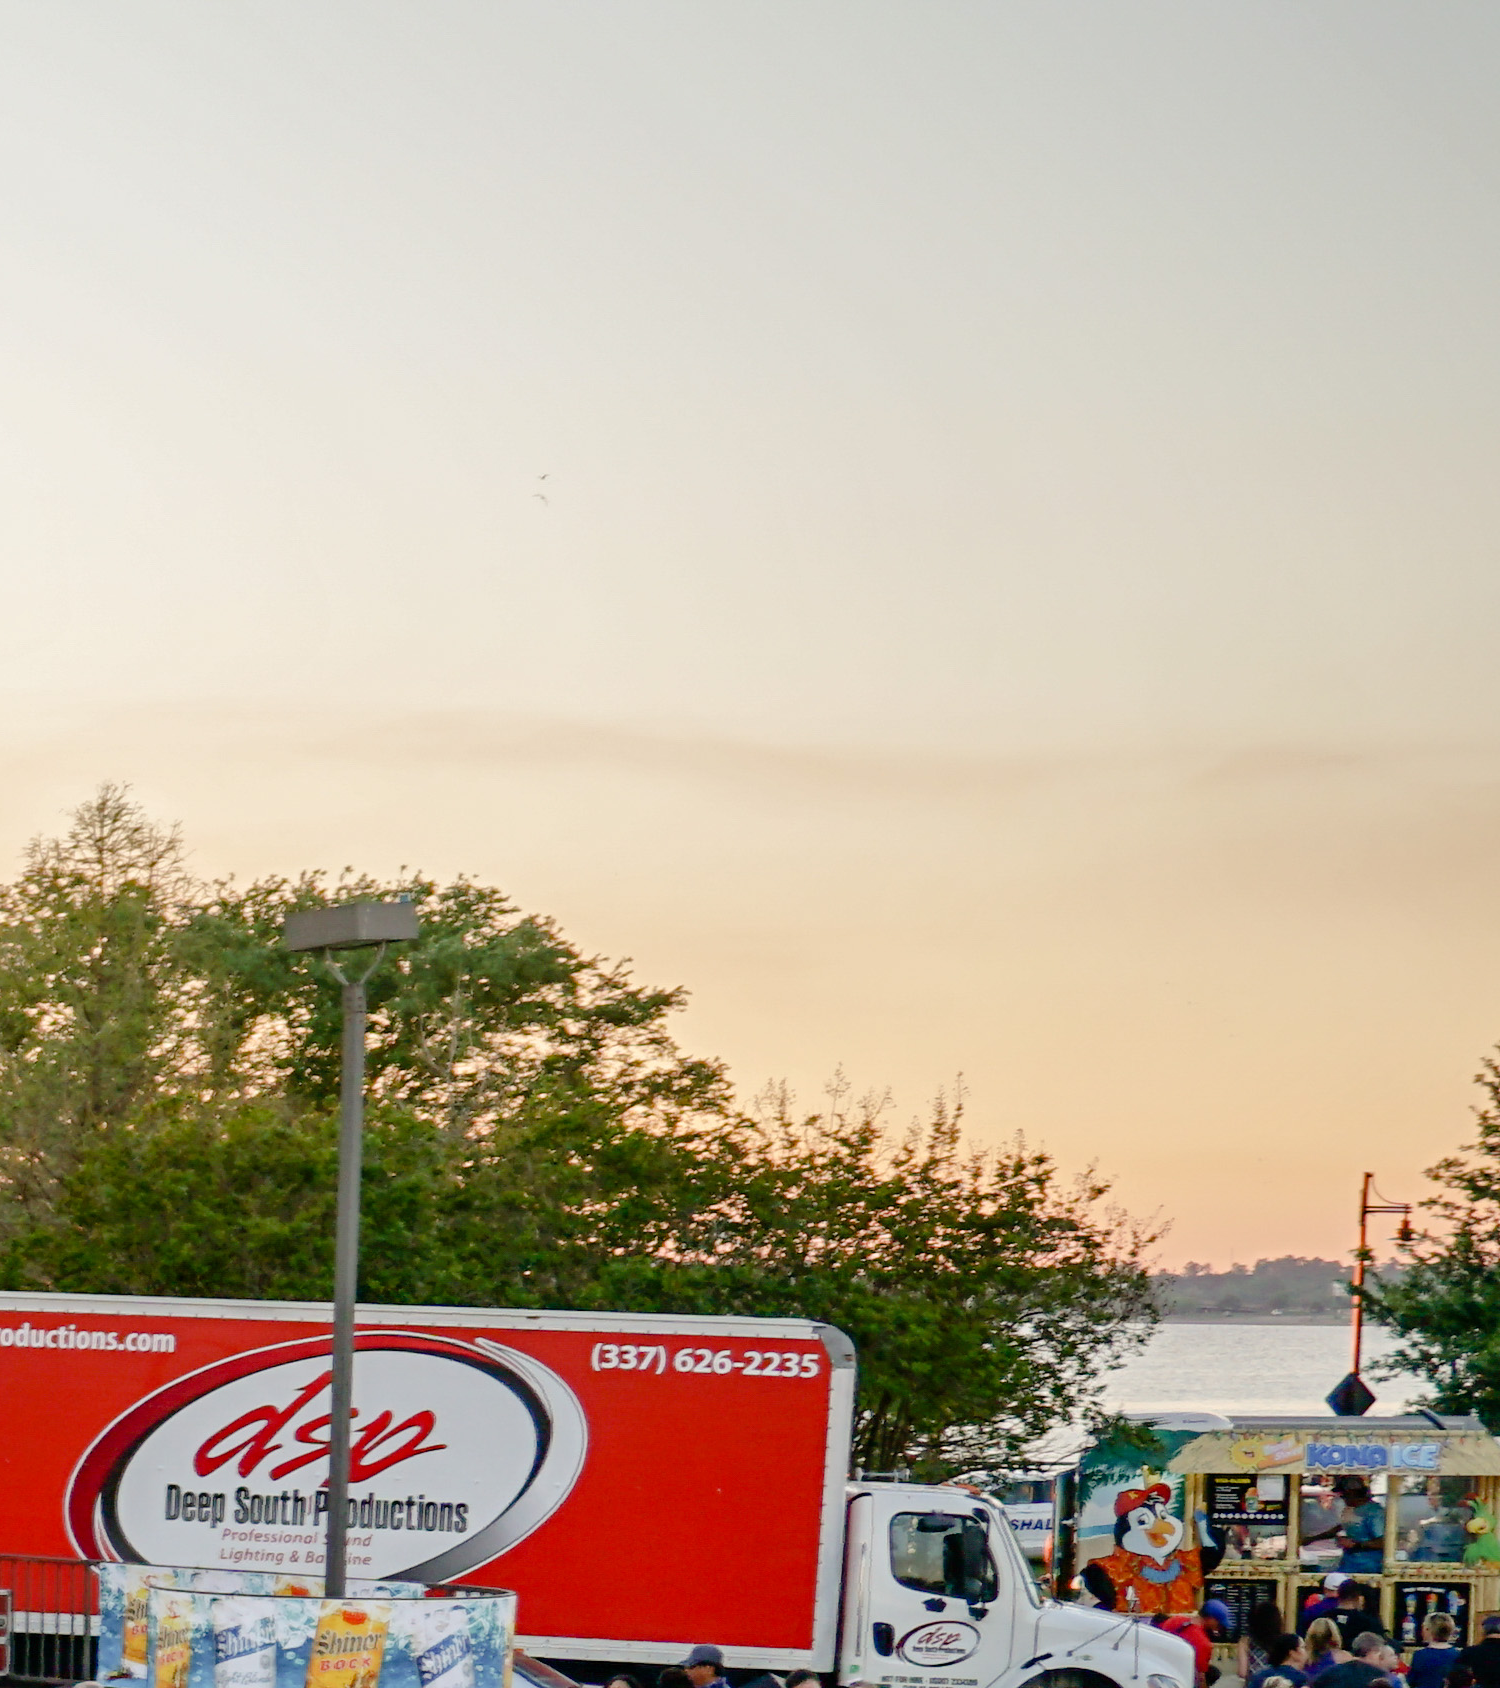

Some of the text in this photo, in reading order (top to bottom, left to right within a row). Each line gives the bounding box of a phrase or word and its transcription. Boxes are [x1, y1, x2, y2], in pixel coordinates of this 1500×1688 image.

[591, 1342, 821, 1378] (337) 626-2235
[1306, 1443, 1388, 1469] KONA
[1392, 1443, 1440, 1469] ICE
[165, 1484, 470, 1533] Deep South Poductions
[222, 1528, 373, 1547] Professional und
[220, 1548, 373, 1566] Lighting & Baine
[315, 1629, 382, 1658] Shiner
[918, 1626, 962, 1646] dsp
[320, 1655, 373, 1673] BOCK
